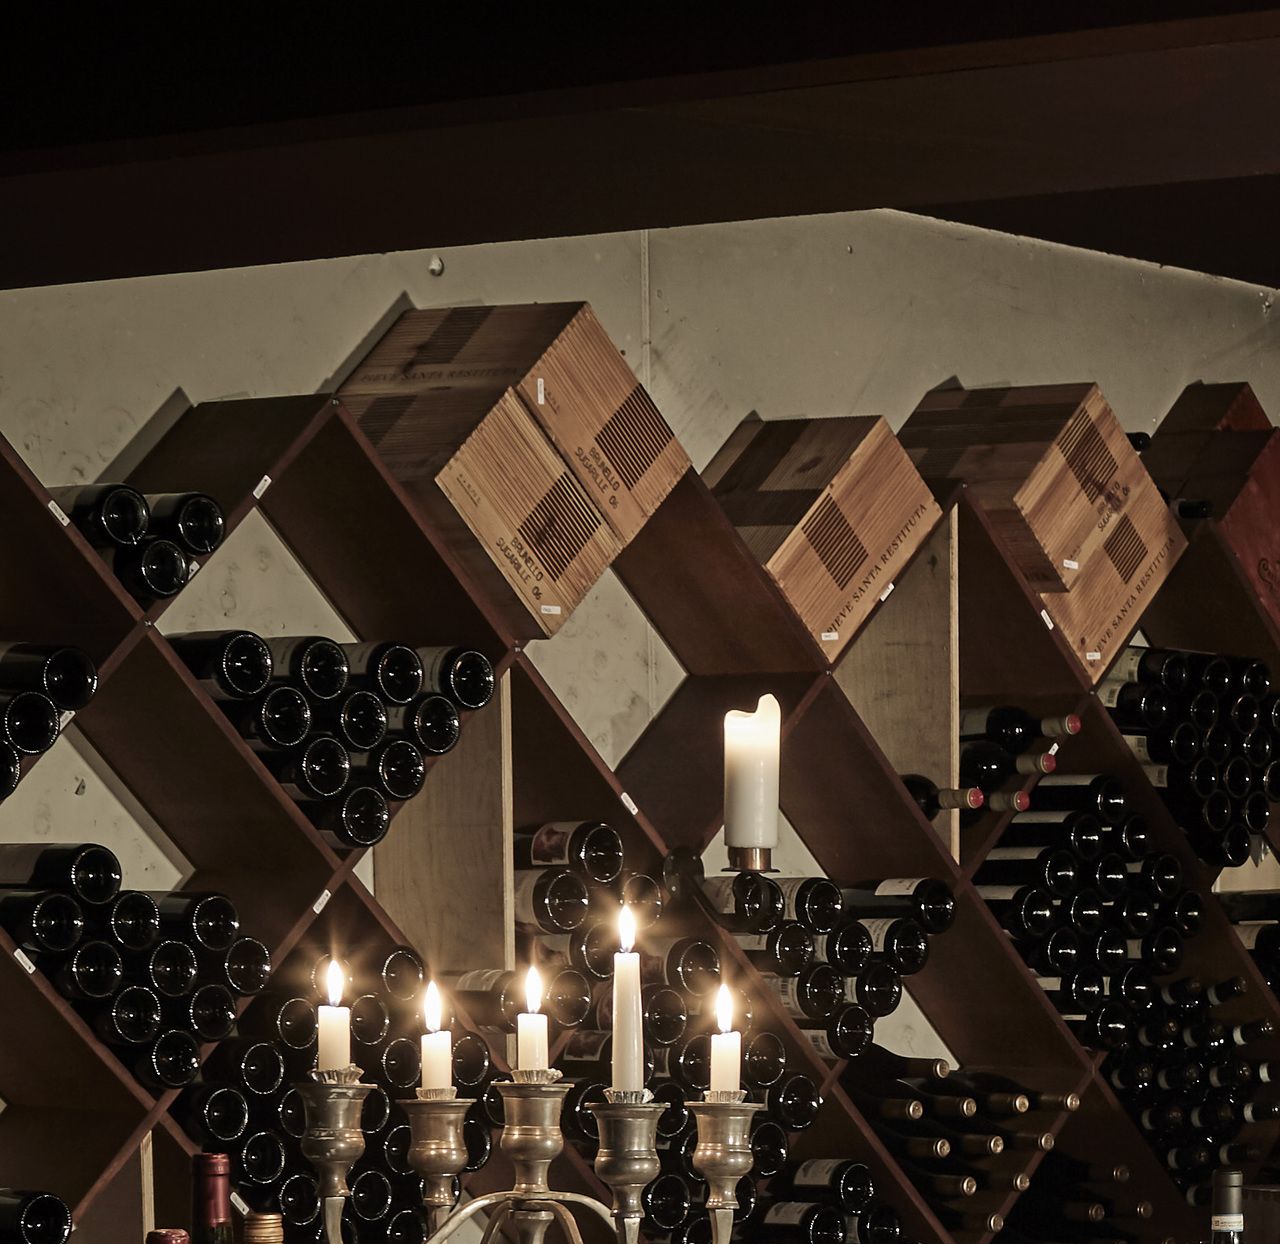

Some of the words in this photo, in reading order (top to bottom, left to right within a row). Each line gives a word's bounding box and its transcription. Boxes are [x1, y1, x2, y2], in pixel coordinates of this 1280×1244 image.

[496, 537, 531, 585] SUGARILLE
[510, 536, 545, 582] BRUNELLO
[852, 564, 882, 603] SANTA
[881, 503, 927, 565] RESTITUTA
[1111, 596, 1137, 630] SANTA
[1135, 536, 1175, 595] RESTITUTA
